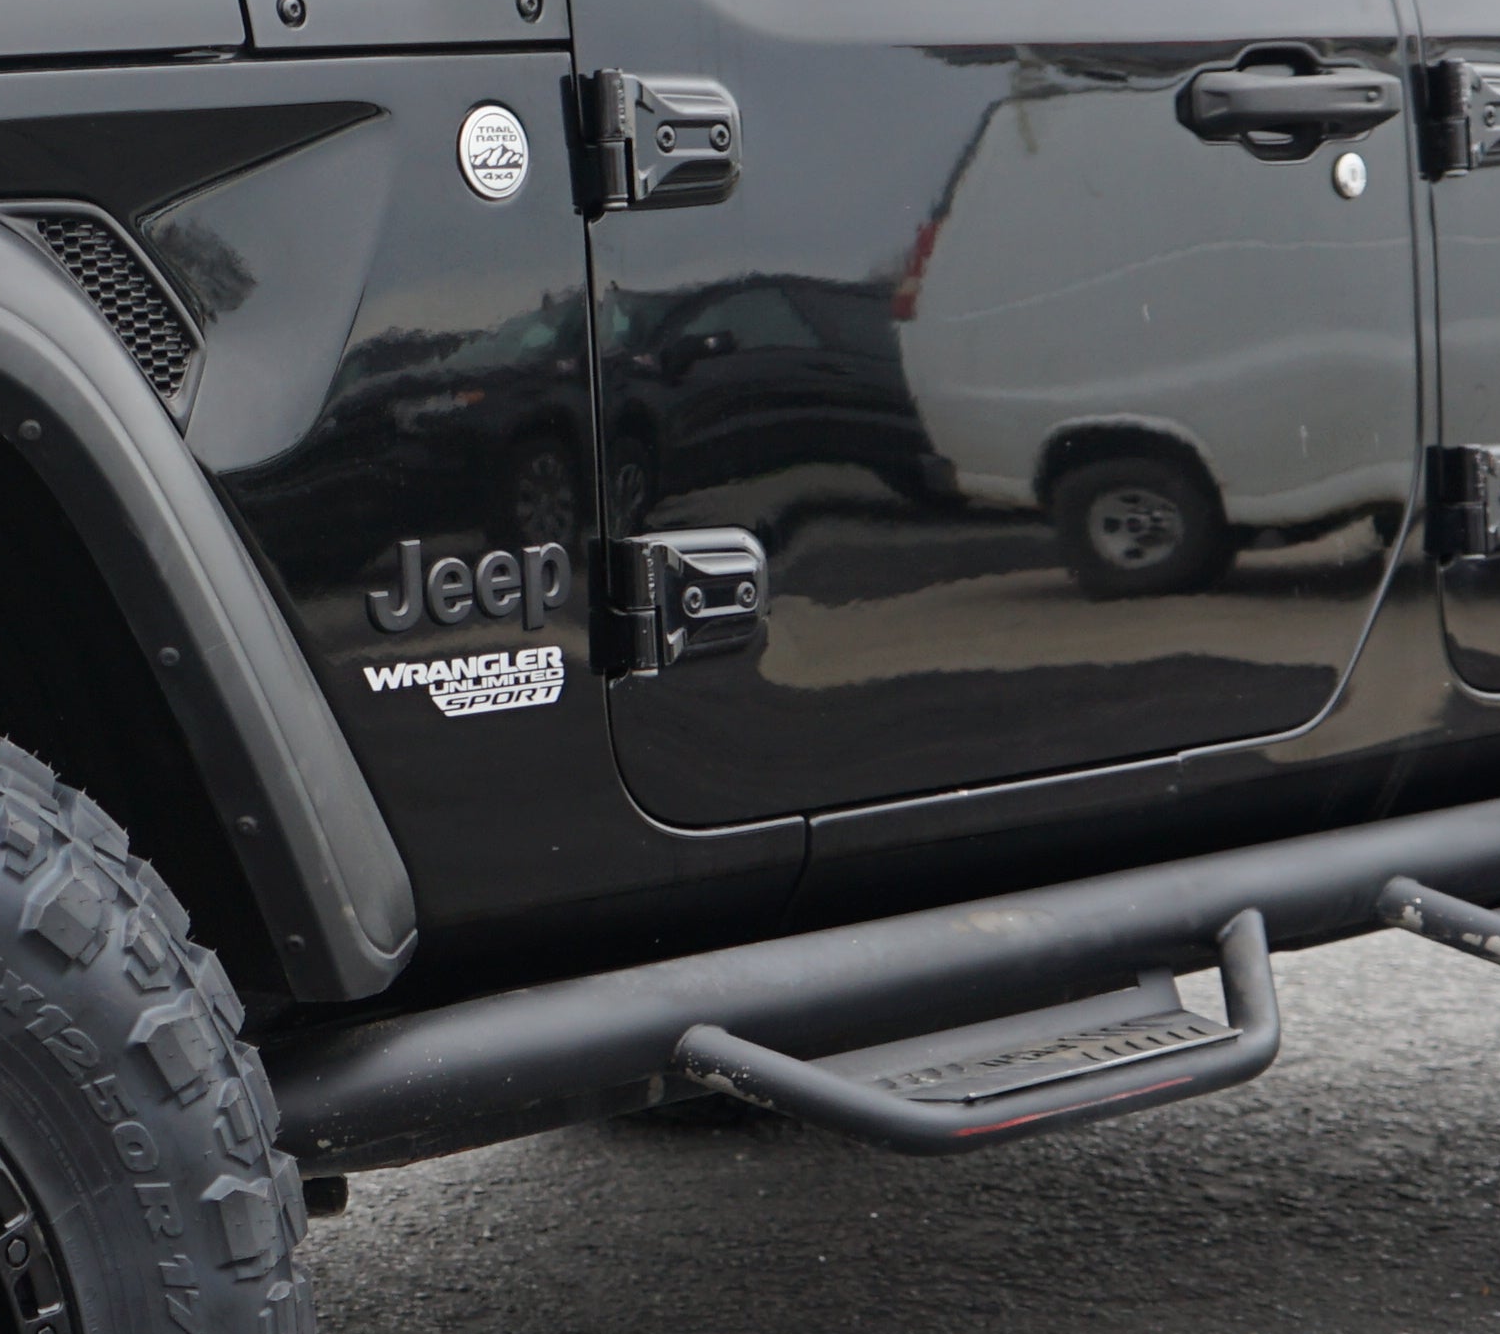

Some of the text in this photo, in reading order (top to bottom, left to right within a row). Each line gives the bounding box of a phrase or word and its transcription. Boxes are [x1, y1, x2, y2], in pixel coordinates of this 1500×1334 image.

[475, 134, 518, 142] RATED
[477, 126, 514, 134] TRAIL
[366, 539, 572, 635] Jeep
[363, 645, 565, 692] WRANGLER
[429, 667, 565, 697] UNLIMITED
[445, 685, 560, 711] SPORT
